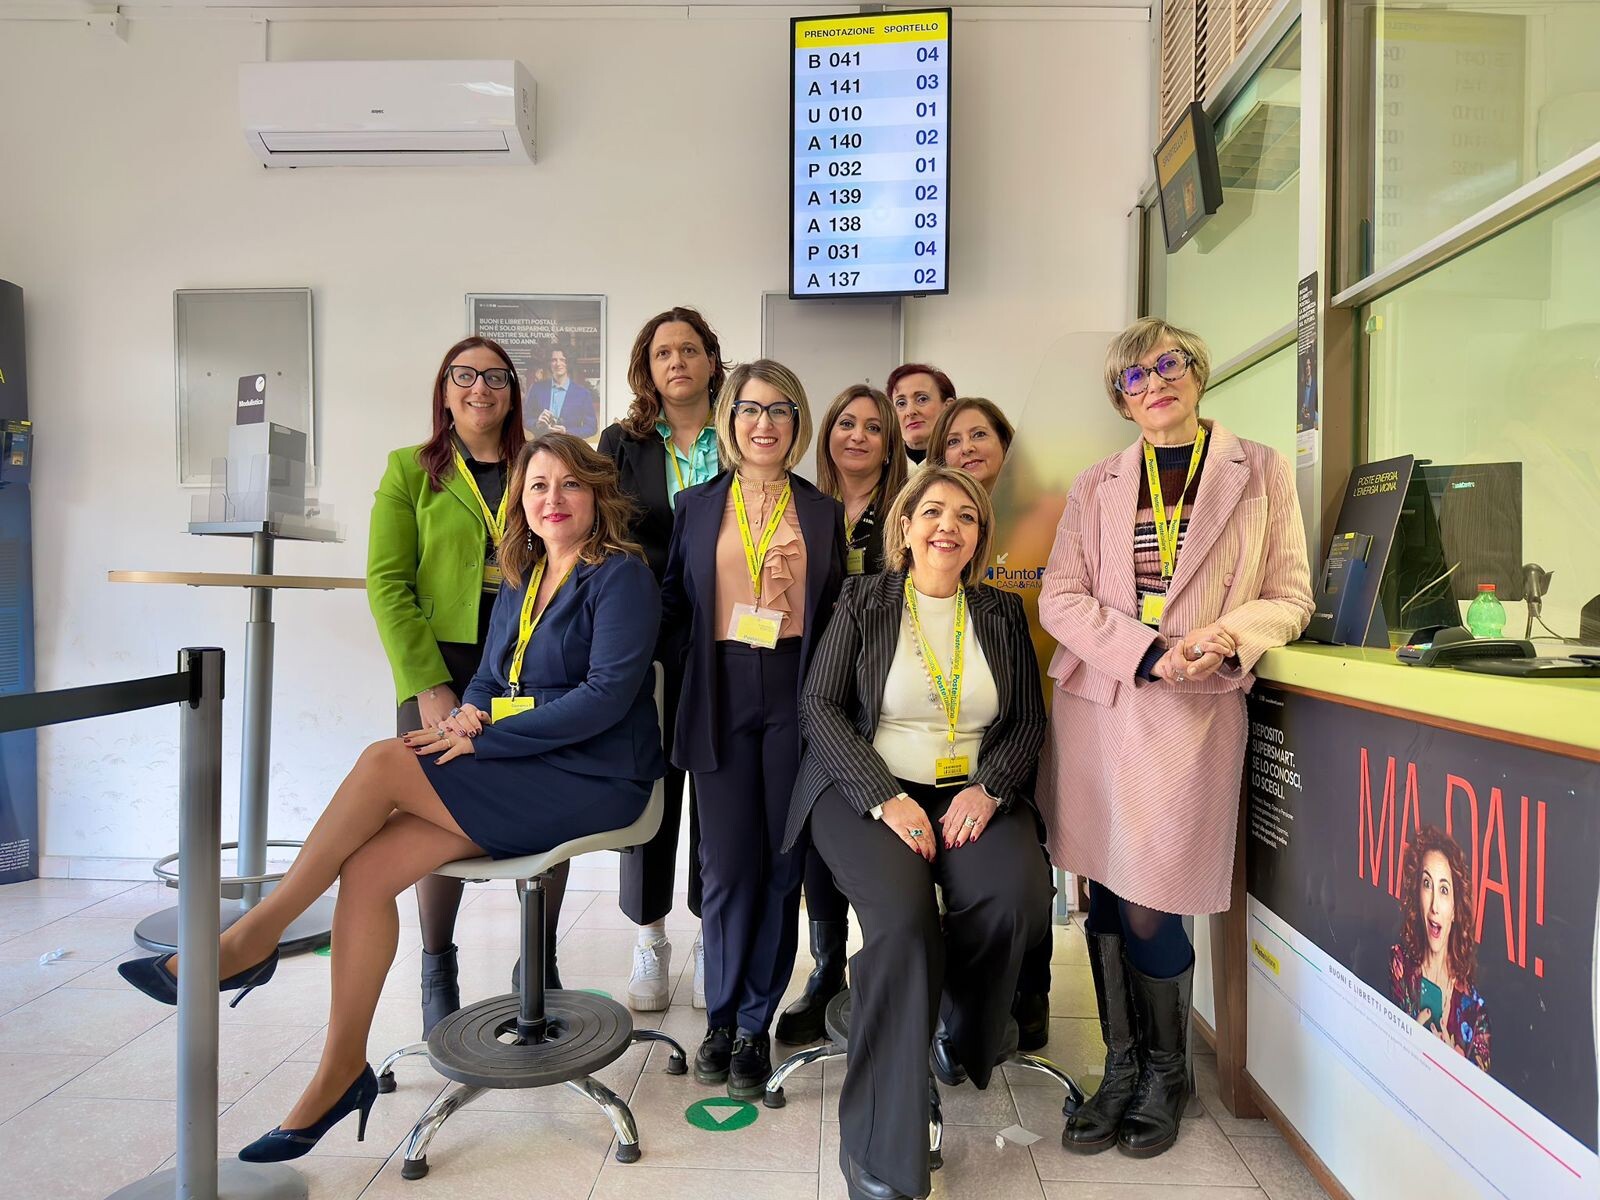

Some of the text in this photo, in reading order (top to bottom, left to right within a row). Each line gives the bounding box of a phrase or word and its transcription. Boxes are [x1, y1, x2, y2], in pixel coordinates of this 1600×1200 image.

[804, 22, 938, 38] PRENOTAZIONE SPORTELLO
[809, 46, 939, 69] B 041 04
[808, 74, 939, 96] A 141 03
[809, 102, 936, 123] U 010 01
[808, 129, 938, 150] A 140 02
[809, 157, 936, 178] P 032 01
[808, 185, 938, 205] A 139 02
[808, 212, 937, 233] A 138 03
[808, 241, 937, 260] P 031 04
[807, 268, 936, 288] A 137 02
[1357, 471, 1398, 486] POSTE ENERGIA
[955, 588, 964, 628] Posteitaliane
[953, 630, 962, 671] Posteitaliane
[950, 674, 960, 719] Posteitaliane
[1252, 722, 1284, 745] DEPOSITO
[1252, 739, 1295, 768] SUPERSMART.
[1252, 755, 1303, 792] SE LO CONOSCI,
[1252, 771, 1260, 787] LO
[1261, 776, 1285, 800] SCEGLI.
[1358, 747, 1547, 979] MA DAI!
[1329, 964, 1412, 1036] BUONI E LIBRETTI POSTALI
